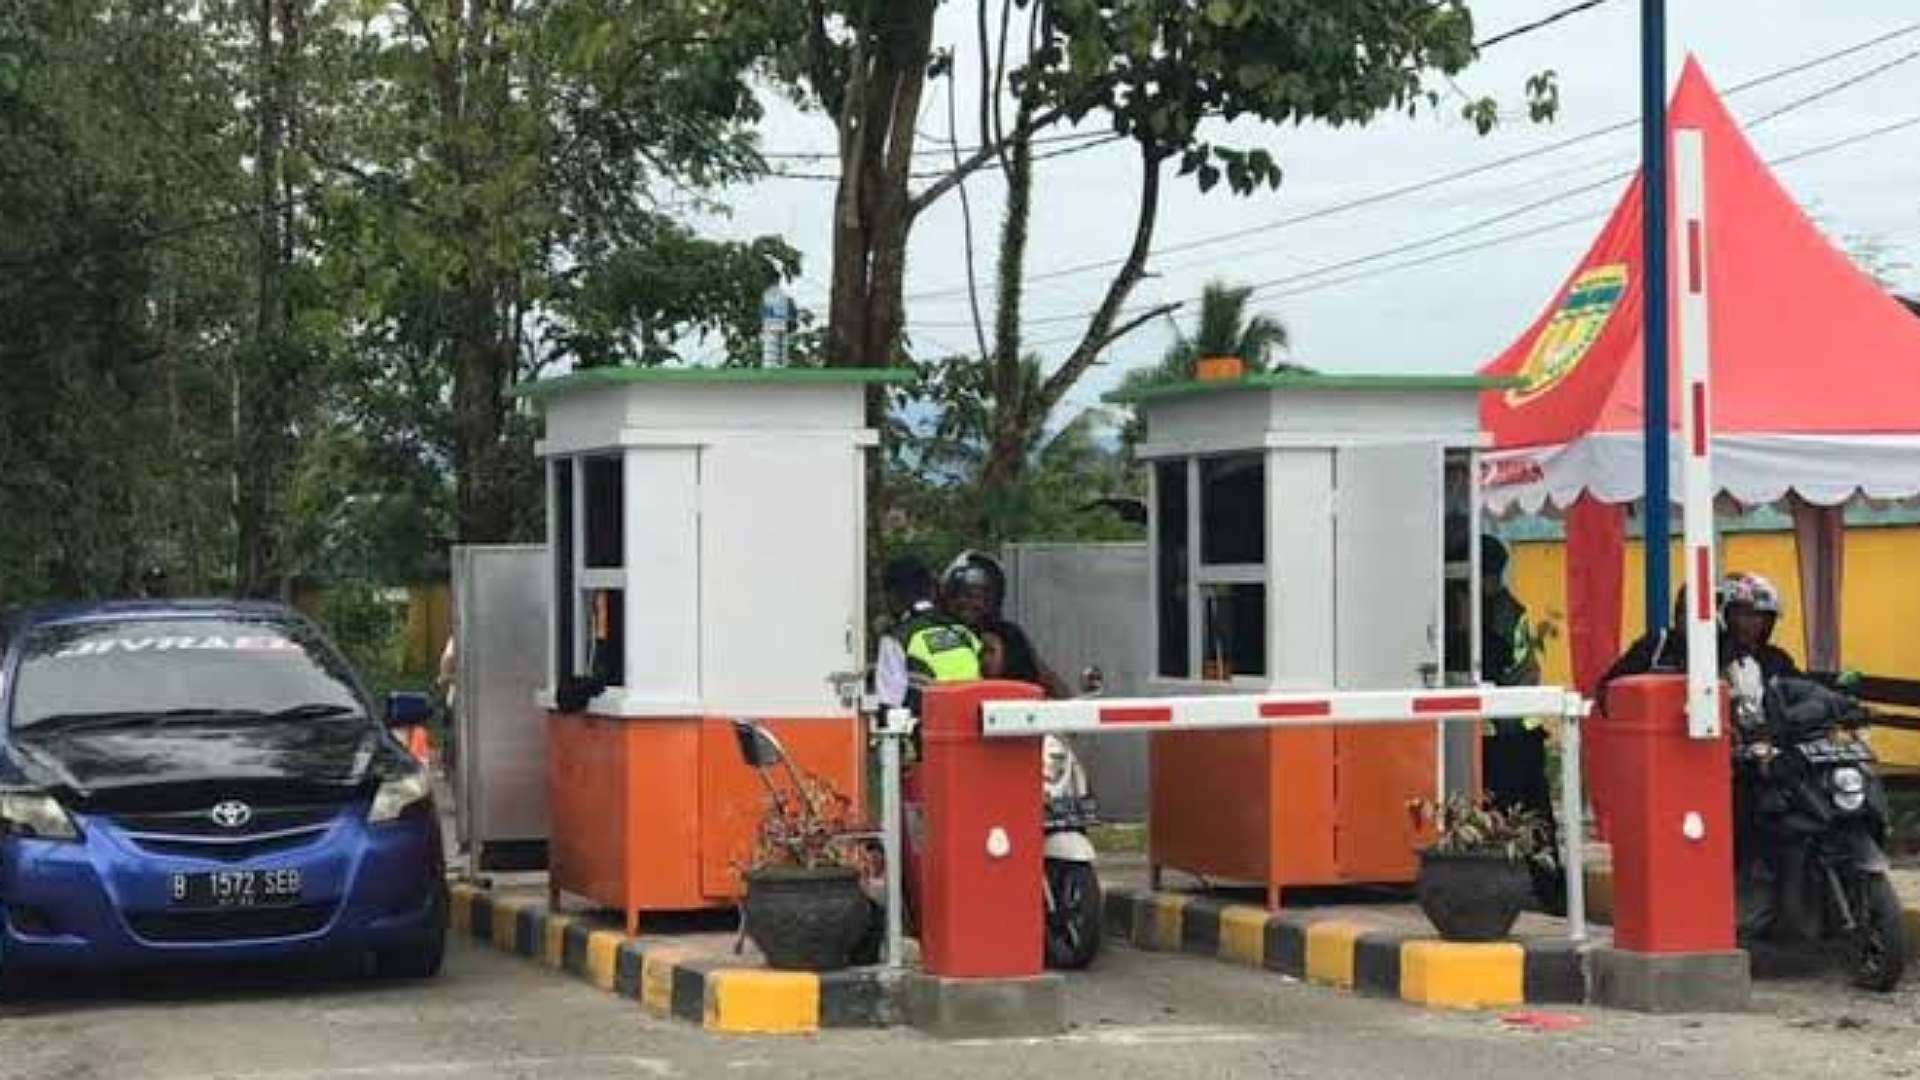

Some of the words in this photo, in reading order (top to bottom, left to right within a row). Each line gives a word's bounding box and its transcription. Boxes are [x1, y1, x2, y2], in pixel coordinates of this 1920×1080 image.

[175, 874, 186, 900] B
[209, 871, 256, 896] 1572
[264, 869, 300, 894] SEB
